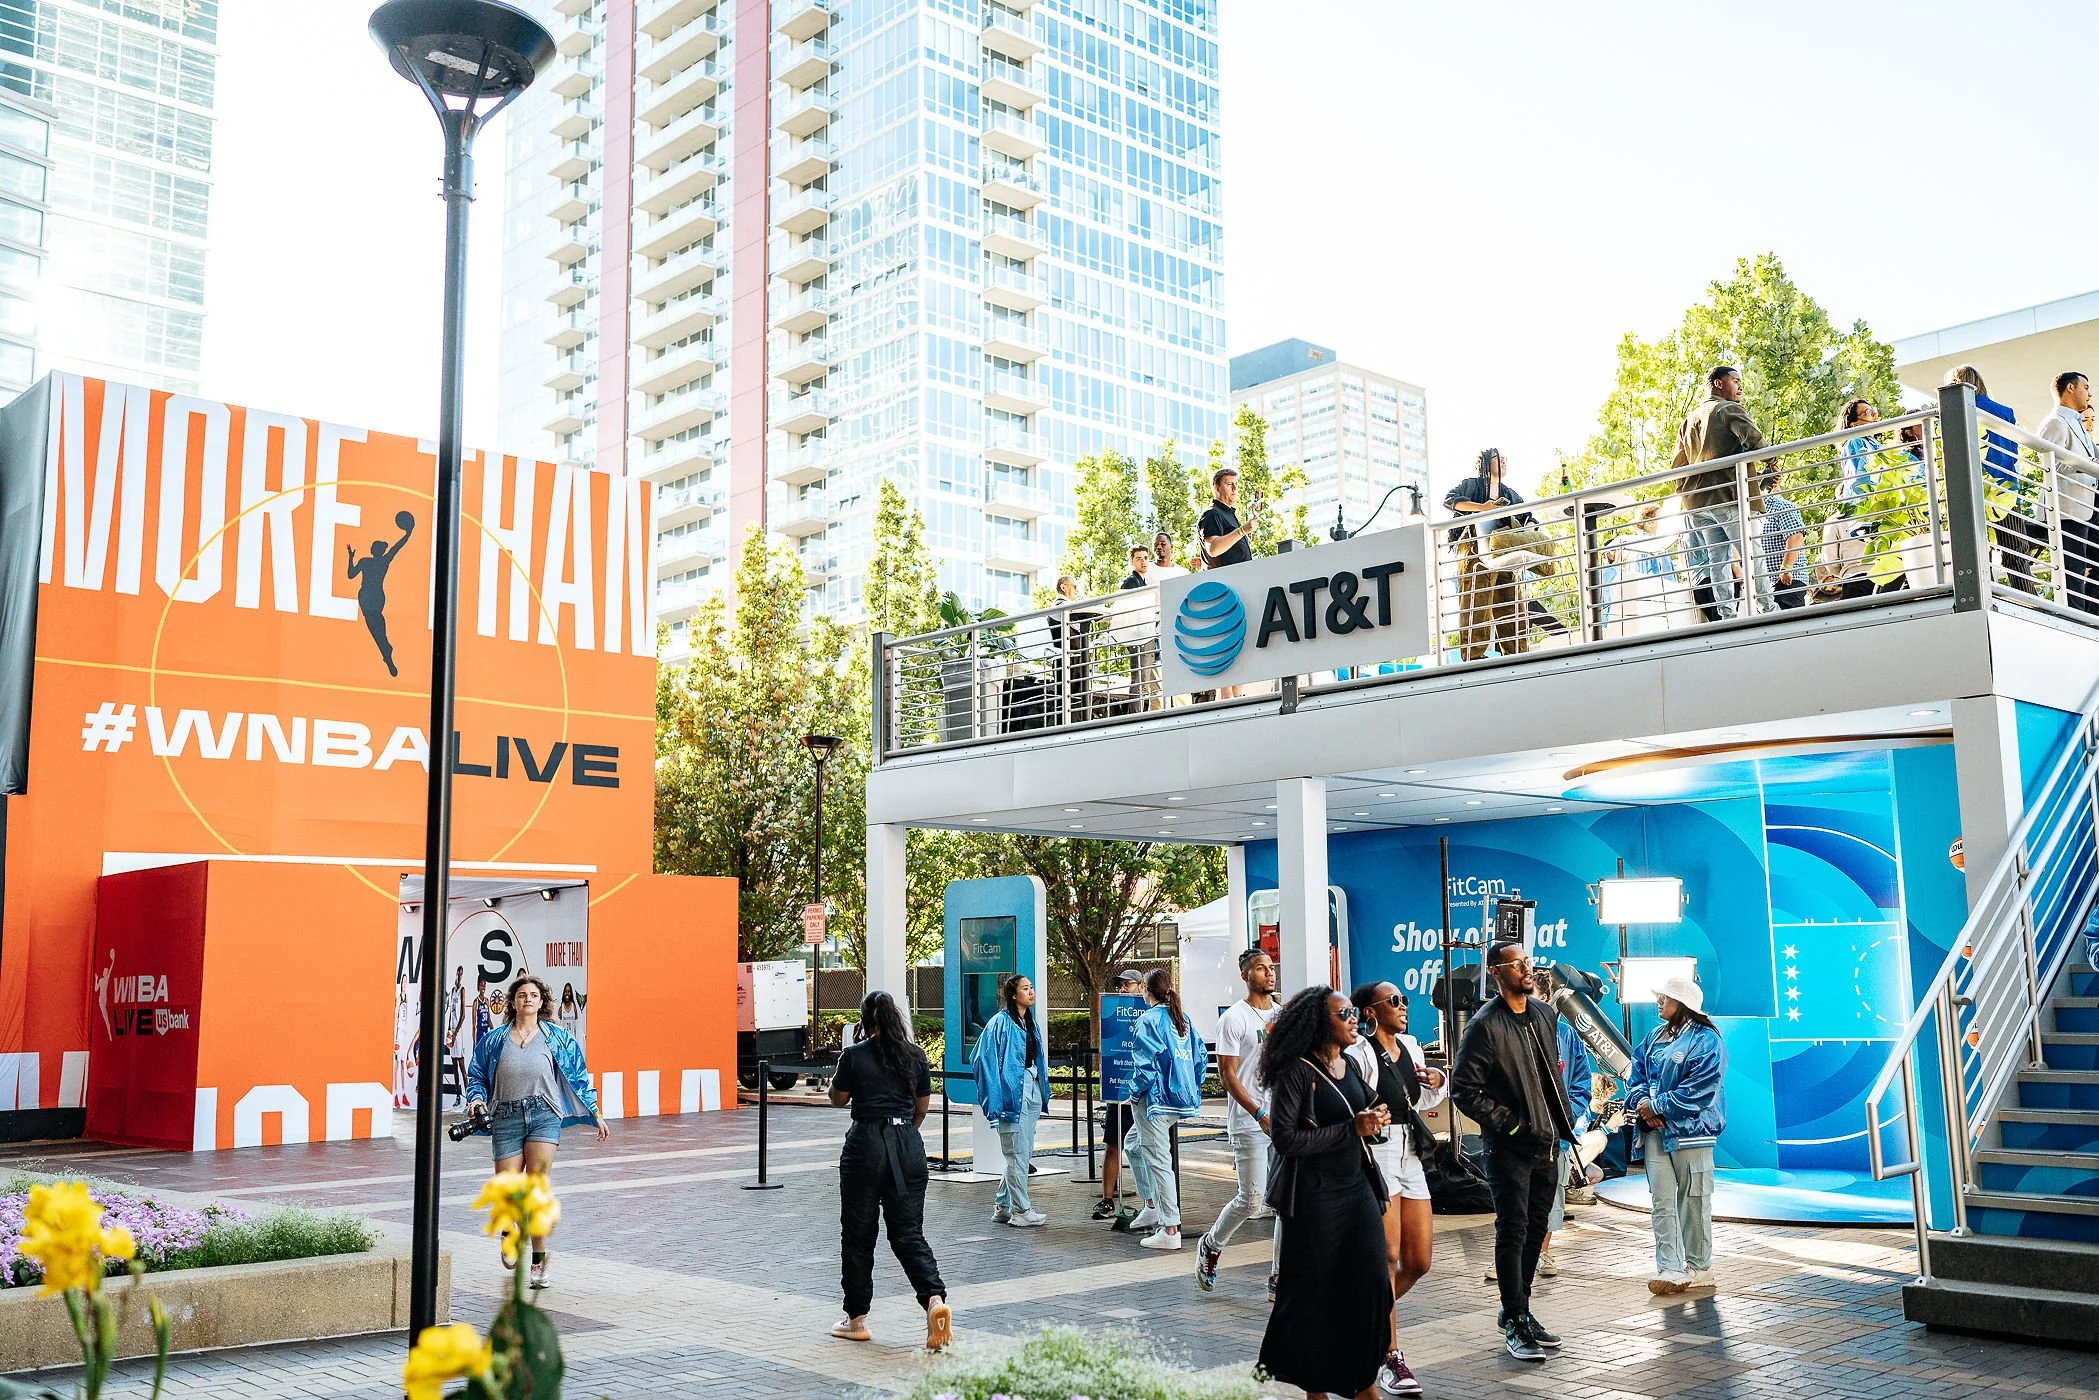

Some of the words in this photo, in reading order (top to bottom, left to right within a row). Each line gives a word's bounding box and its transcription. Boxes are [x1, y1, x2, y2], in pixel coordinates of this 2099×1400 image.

[40, 371, 367, 621] MORE
[1256, 561, 1405, 648] AT&T
[545, 942, 566, 967] MORE
[568, 941, 583, 967] THAN
[972, 943, 1001, 954] FitCam
[168, 1008, 189, 1029] bank
[1587, 1029, 1619, 1059] AT&T
